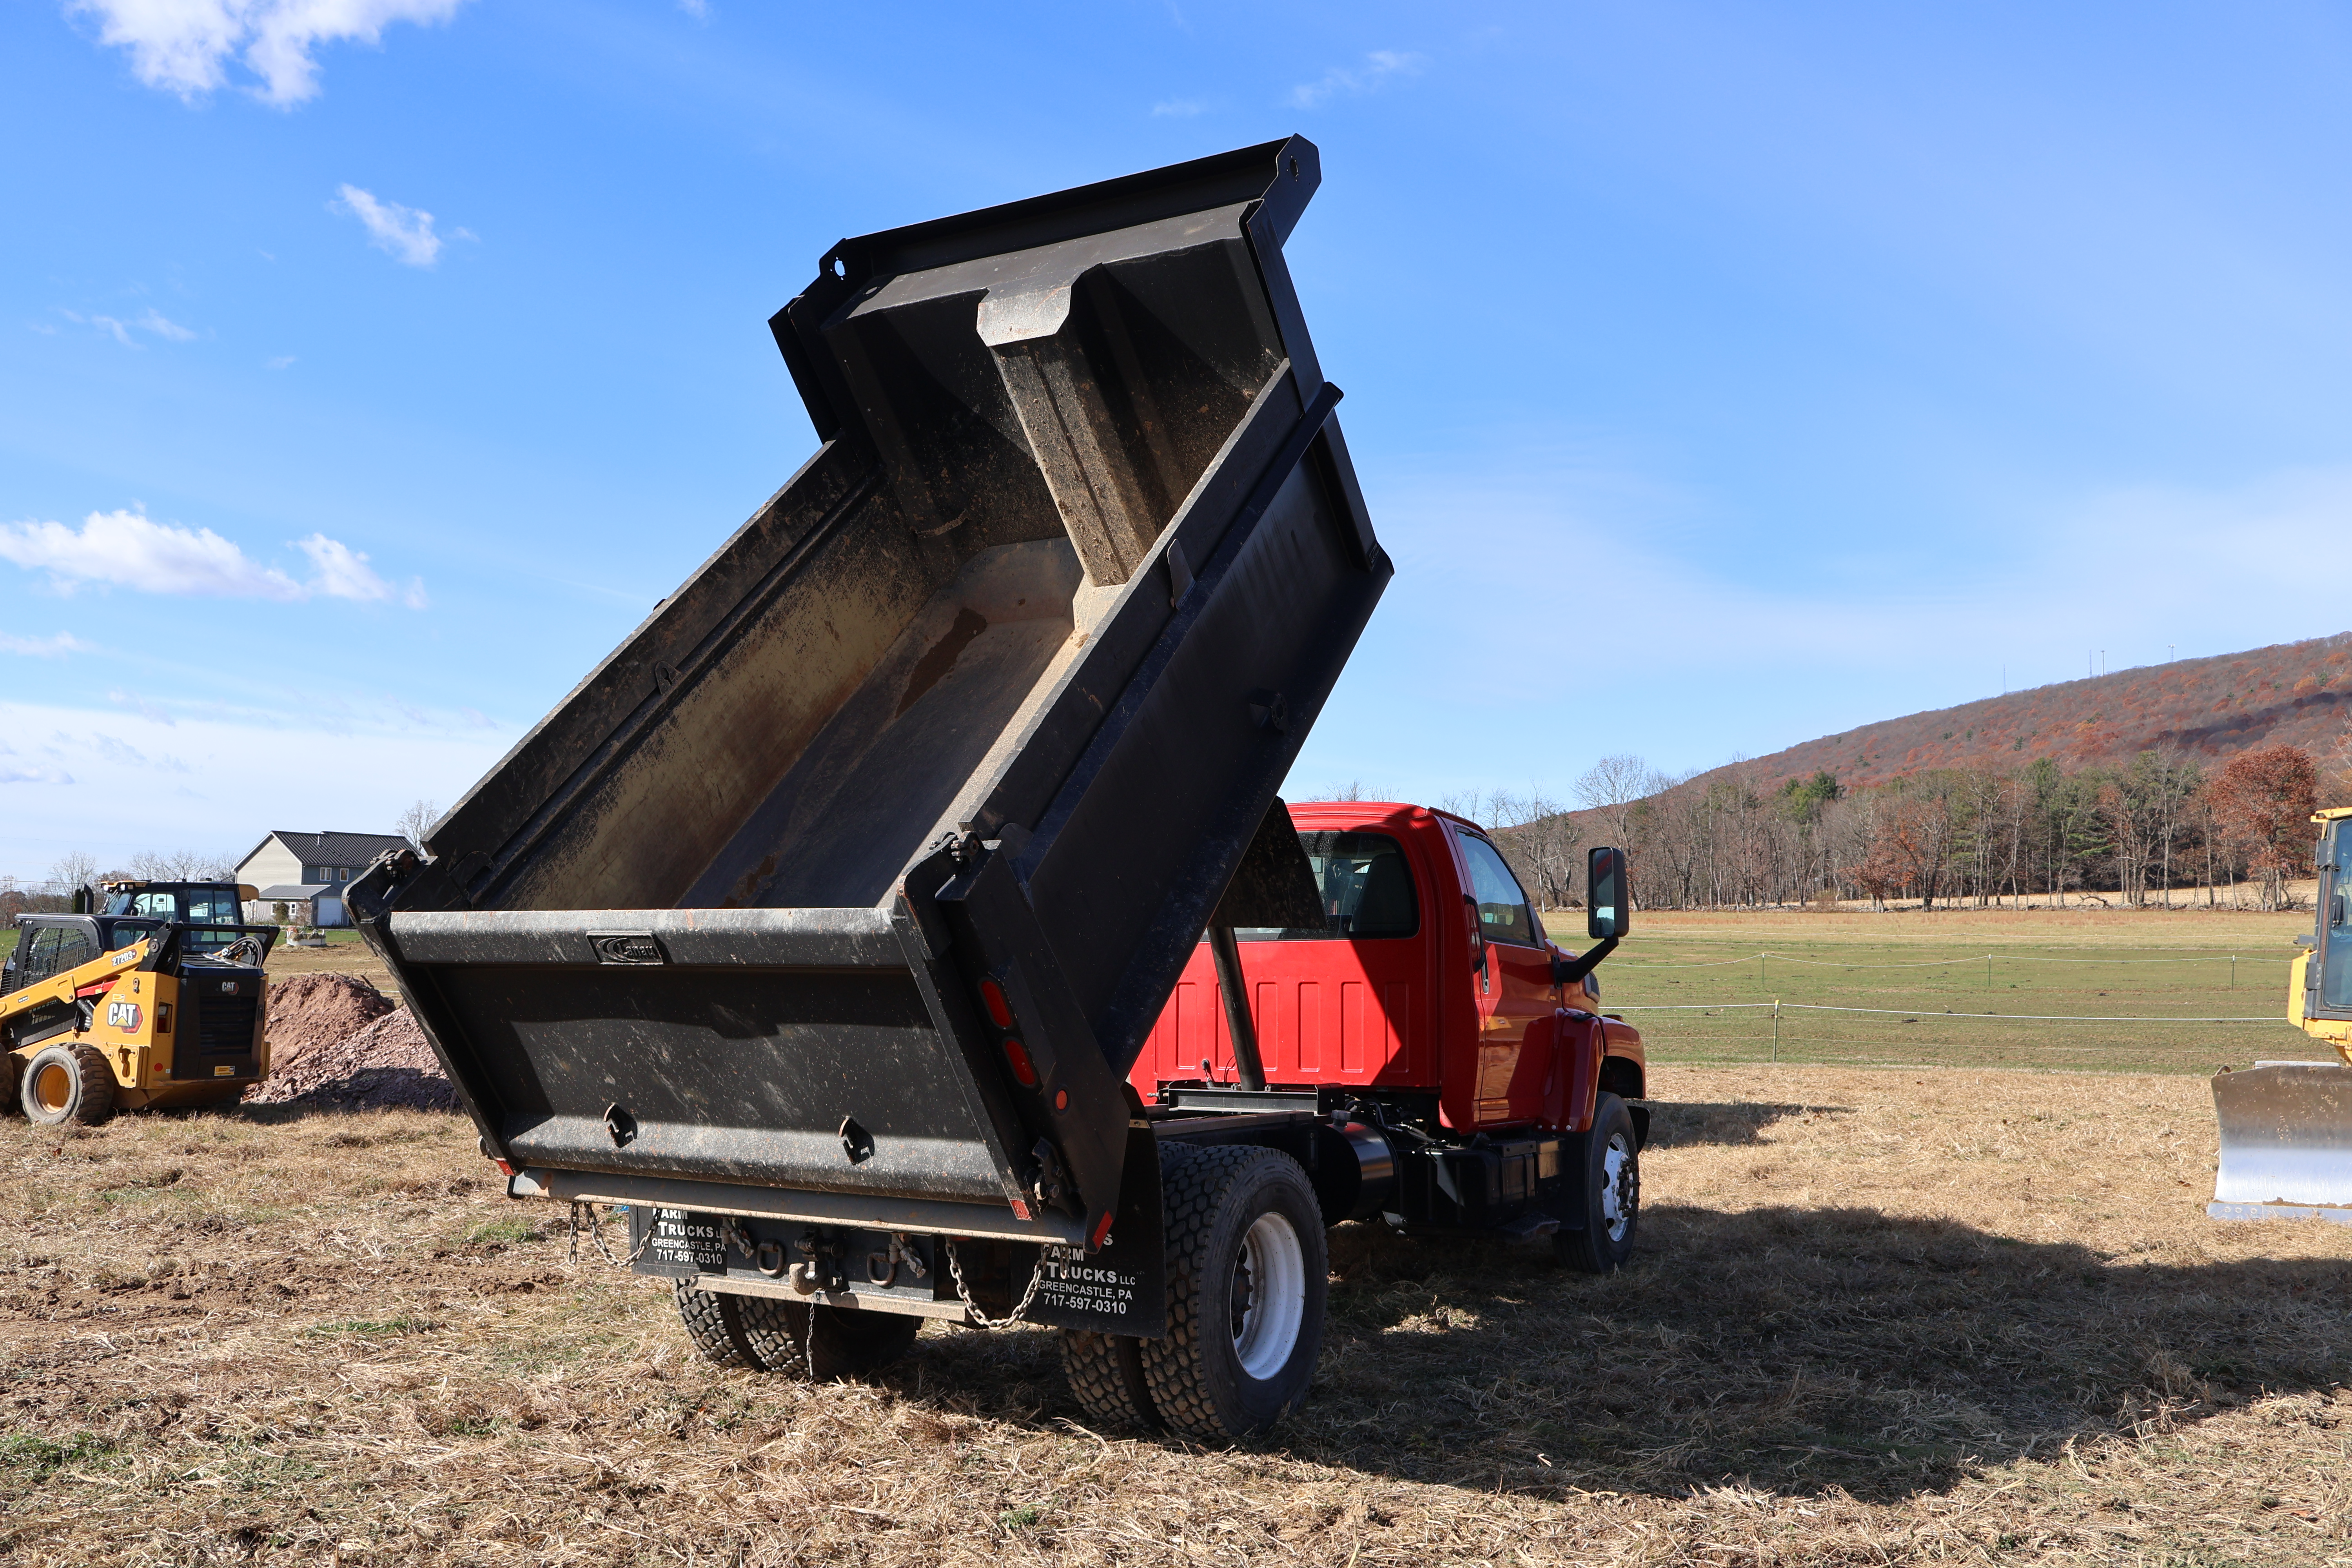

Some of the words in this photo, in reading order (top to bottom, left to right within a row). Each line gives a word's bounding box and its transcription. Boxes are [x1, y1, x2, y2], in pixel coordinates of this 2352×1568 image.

[112, 950, 133, 966] 272D3
[222, 982, 235, 991] CAT
[108, 1003, 136, 1026] CAT
[658, 1221, 714, 1238] TRUCKS
[652, 1237, 713, 1252] GREENCASTLE,
[715, 1241, 726, 1252] PA
[657, 1249, 722, 1264] 717-597-0310
[1047, 1261, 1117, 1283] TUCKS
[1120, 1276, 1136, 1285] LLC
[1039, 1279, 1115, 1300] GREENCASTLE,
[1118, 1289, 1132, 1300] PA
[1044, 1292, 1127, 1314] 717-597-0310
